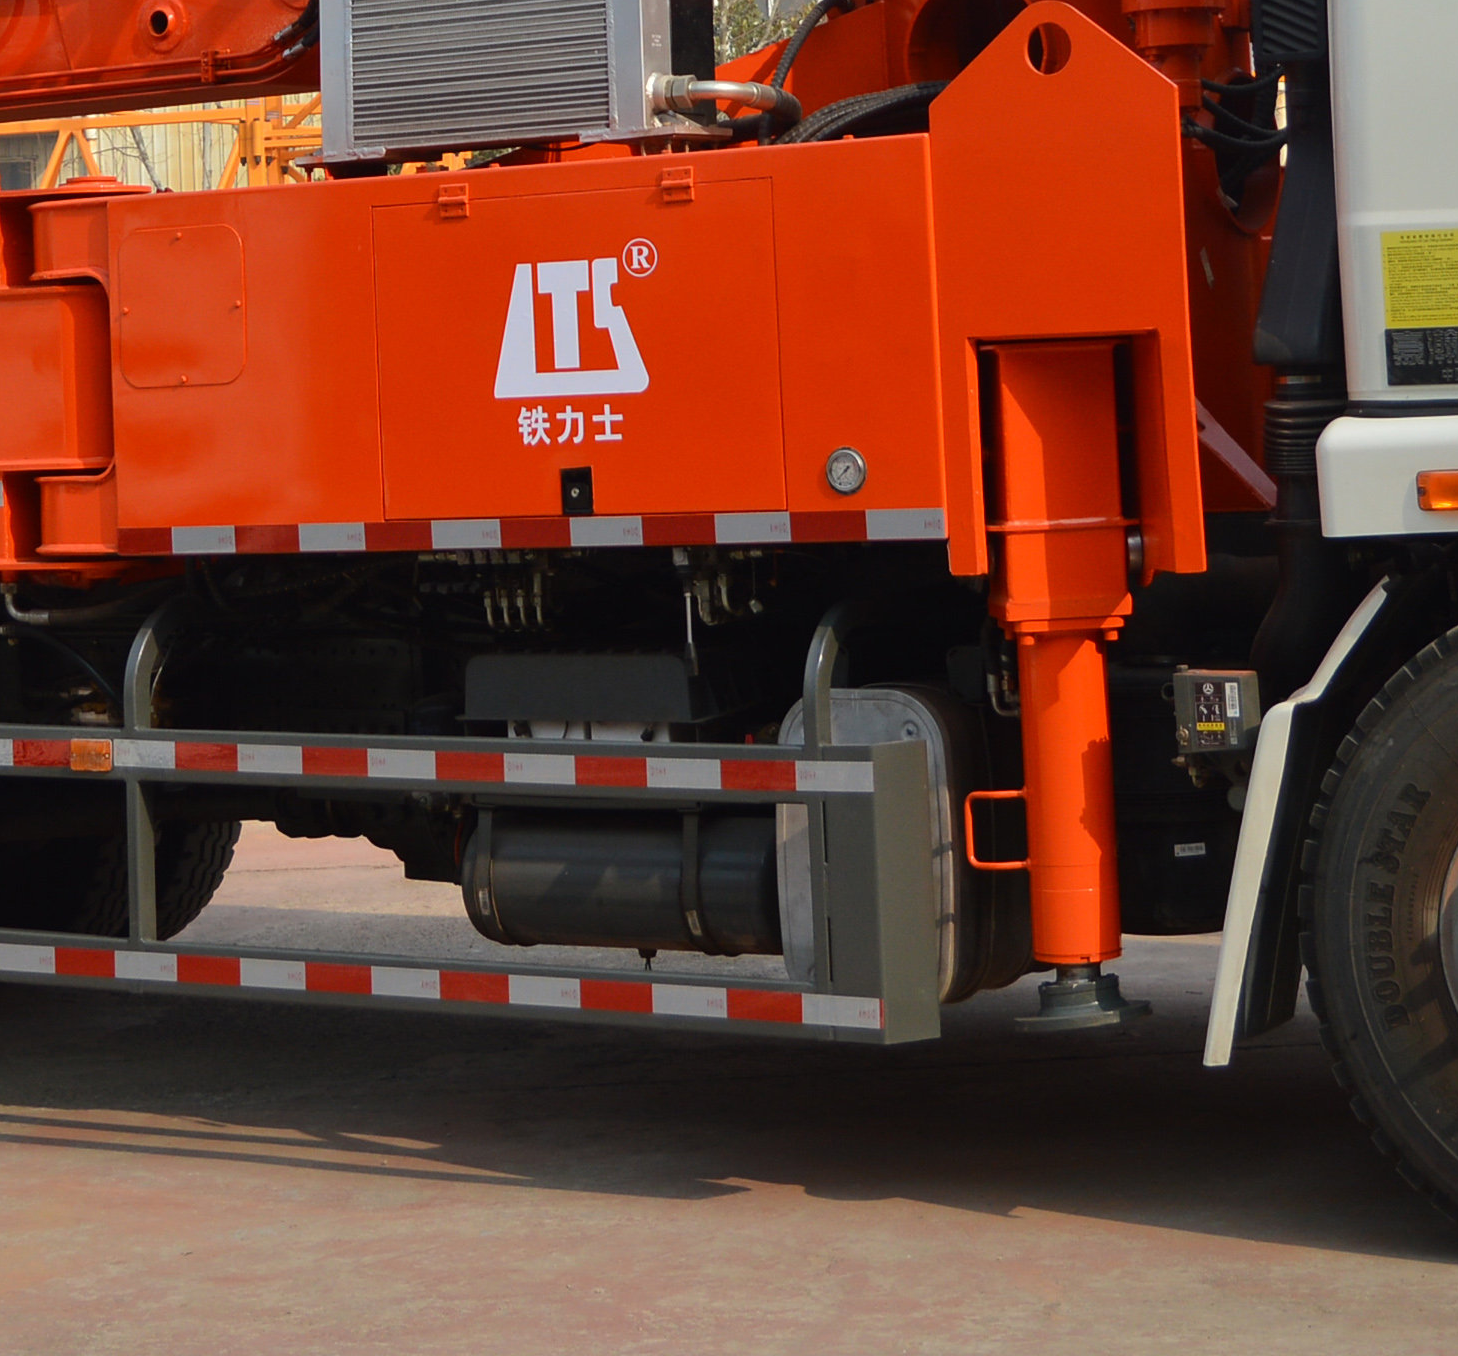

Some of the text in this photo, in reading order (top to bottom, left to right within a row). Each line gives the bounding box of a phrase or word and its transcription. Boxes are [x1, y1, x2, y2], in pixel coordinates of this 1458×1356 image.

[518, 404, 623, 445] 铁力士
[1366, 781, 1432, 1032] DOUBLE STAR
